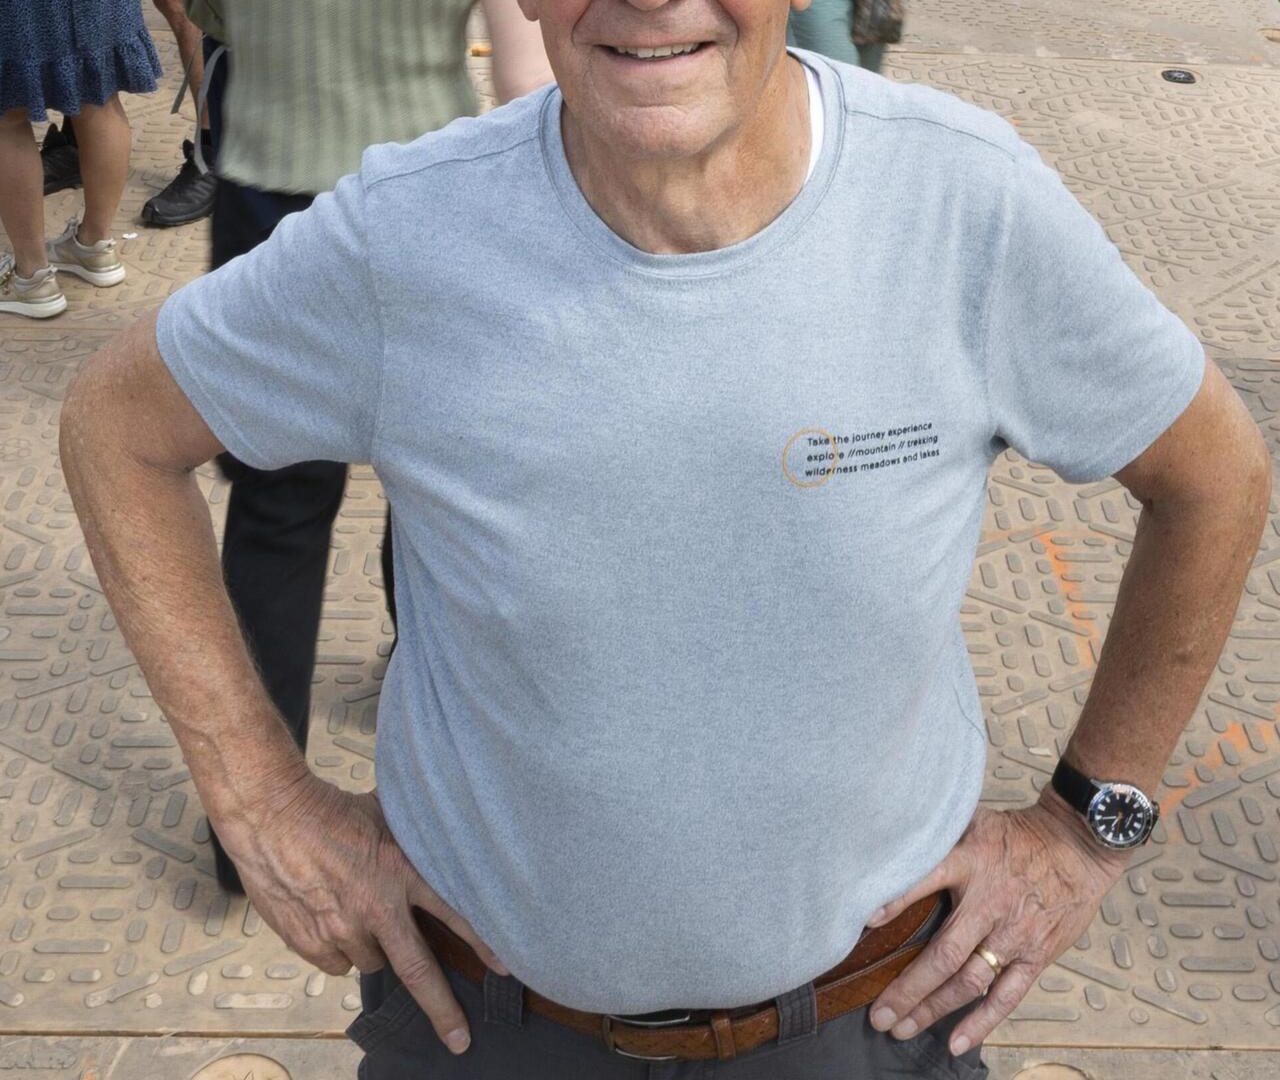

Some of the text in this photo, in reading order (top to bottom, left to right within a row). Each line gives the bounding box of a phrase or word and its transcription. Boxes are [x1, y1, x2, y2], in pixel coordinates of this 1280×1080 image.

[807, 422, 932, 447] Take the journey experience
[907, 434, 938, 448] trekking
[805, 449, 940, 477] wilderness meadows and lakes
